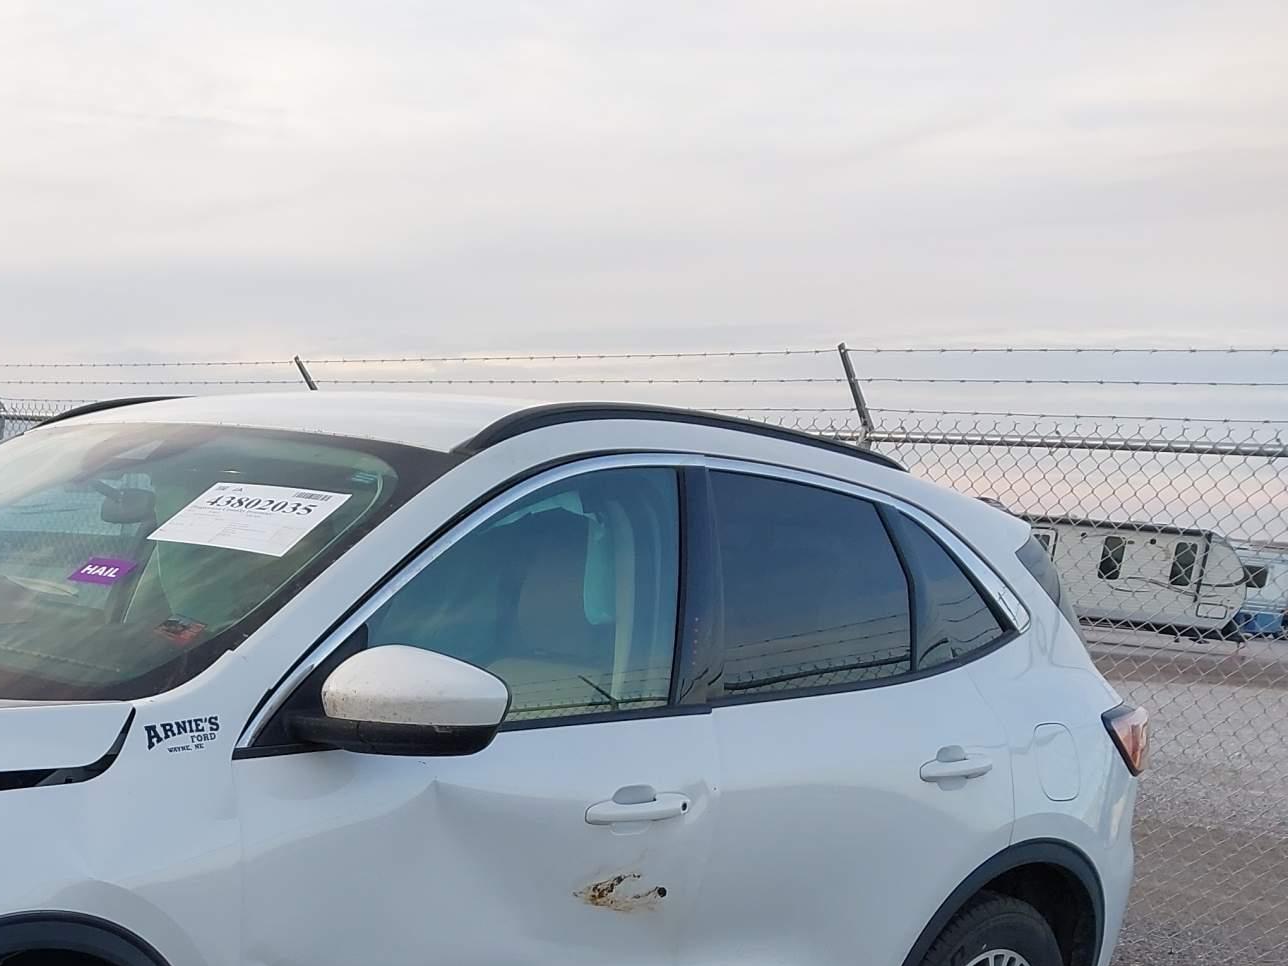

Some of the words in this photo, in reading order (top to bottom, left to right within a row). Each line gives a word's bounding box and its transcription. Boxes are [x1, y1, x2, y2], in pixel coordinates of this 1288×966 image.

[206, 495, 318, 516] 43802035
[80, 564, 120, 578] HAIL
[144, 715, 220, 751] ARNIE'S
[190, 732, 216, 744] FORD
